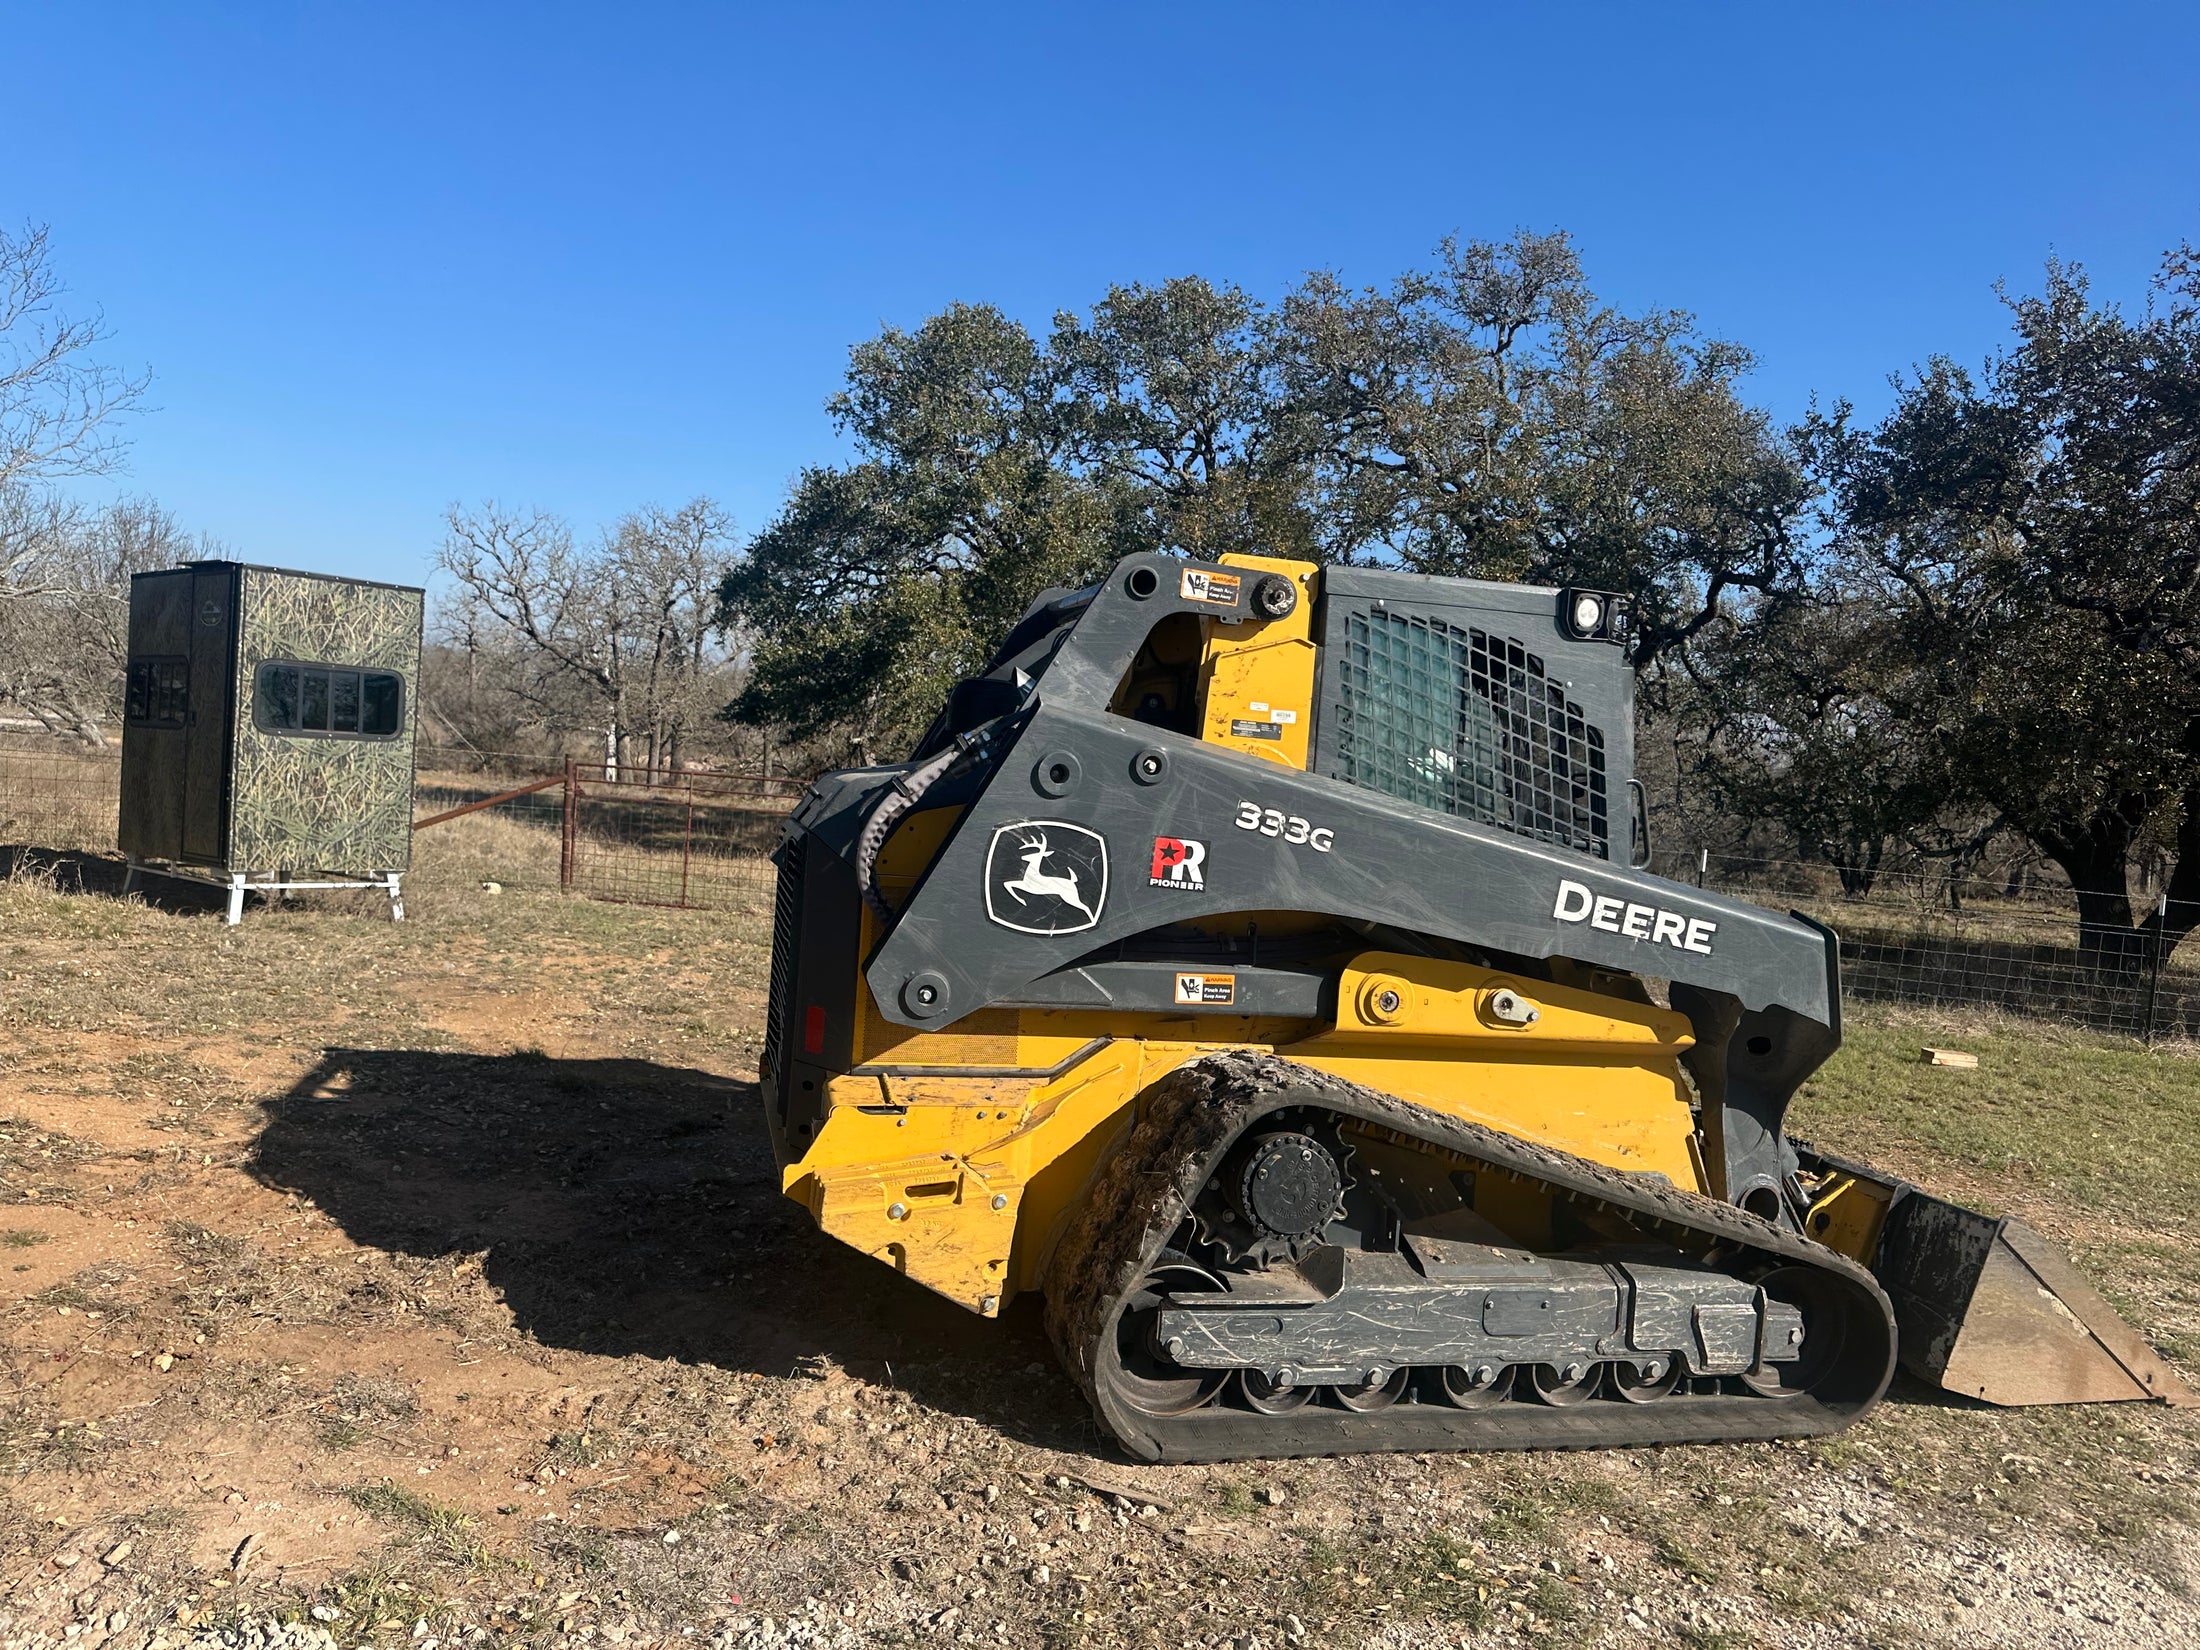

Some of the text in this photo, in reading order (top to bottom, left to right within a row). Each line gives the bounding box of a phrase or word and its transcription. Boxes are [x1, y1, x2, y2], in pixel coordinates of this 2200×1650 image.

[1235, 801, 1335, 853] 333G
[1149, 878, 1205, 891] PIONEER
[1151, 837, 1206, 883] PR
[1553, 879, 1717, 955] DEERE
